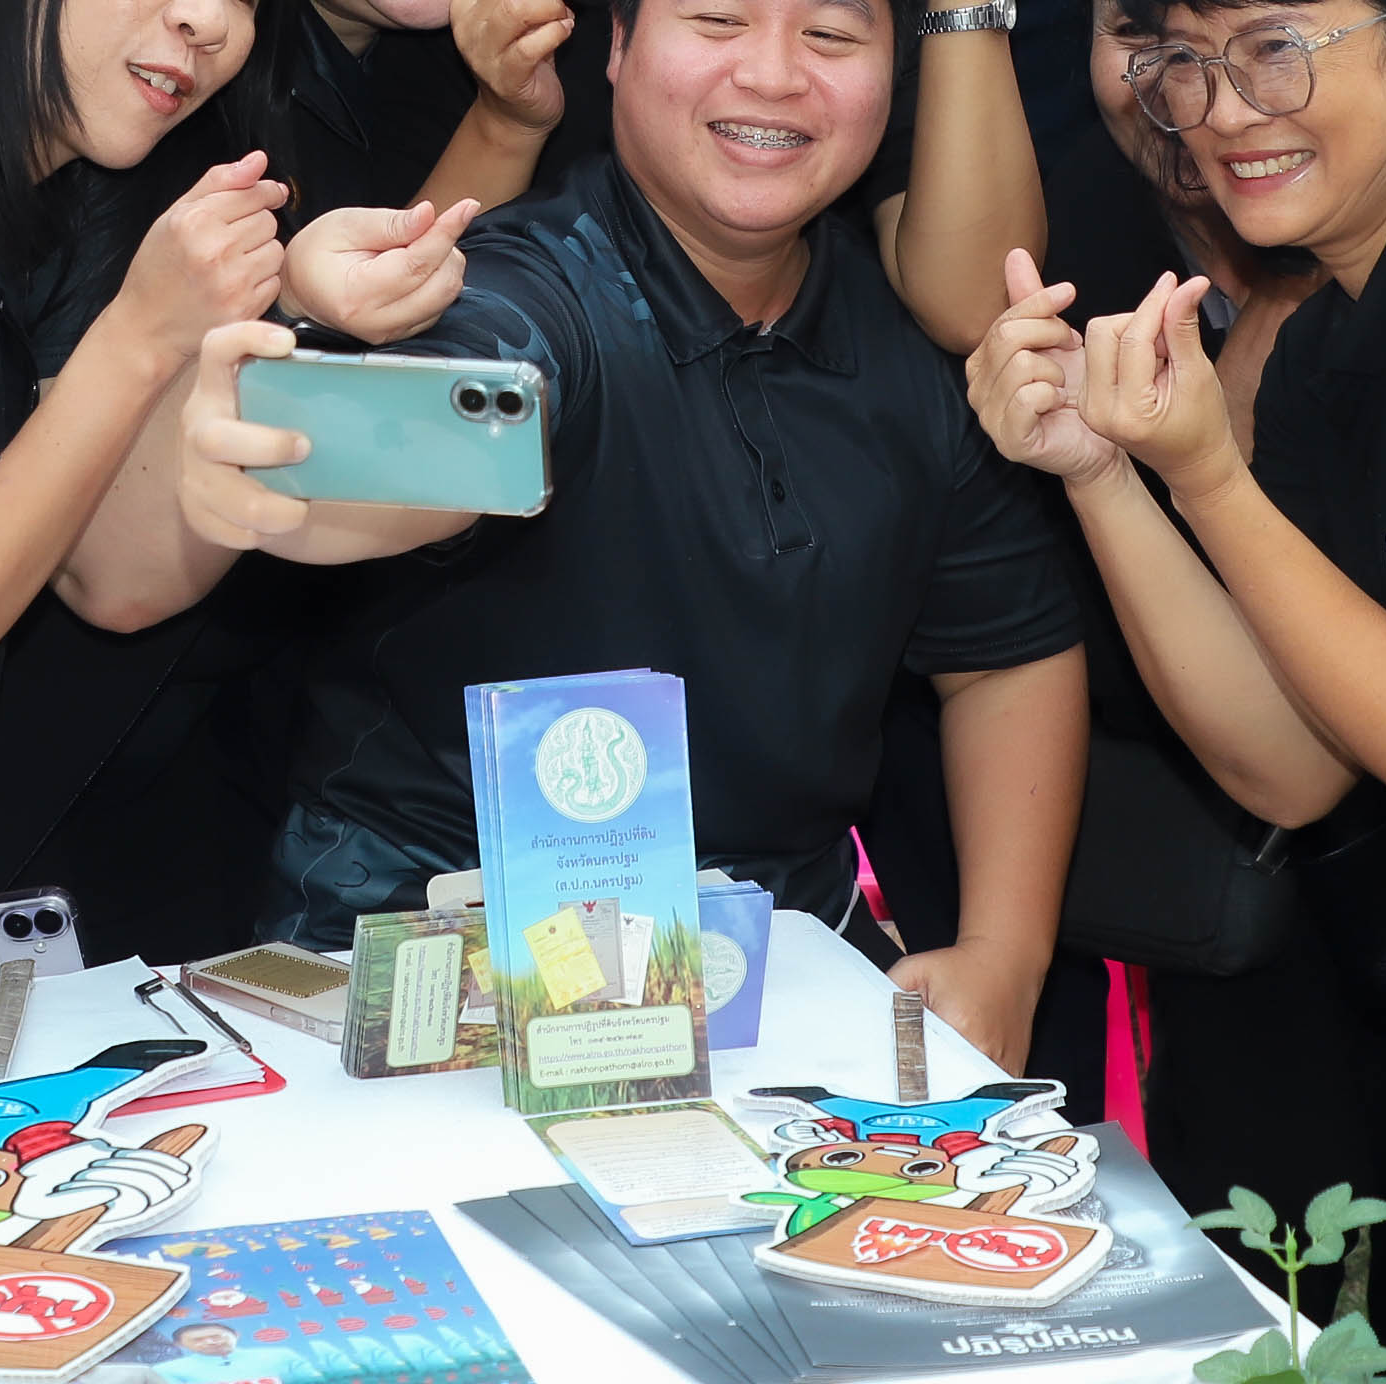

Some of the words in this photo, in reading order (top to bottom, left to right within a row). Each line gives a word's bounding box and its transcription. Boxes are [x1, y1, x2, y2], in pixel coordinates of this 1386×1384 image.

[531, 823, 657, 850] สำนักงานการปฏิรูปที่ดิน
[556, 852, 640, 870] จังหวัดนครปฐม
[555, 872, 644, 893] (ส.ป.ก.นครปฐม)
[941, 1323, 1139, 1357] ปฏิรูปที่ดิน
